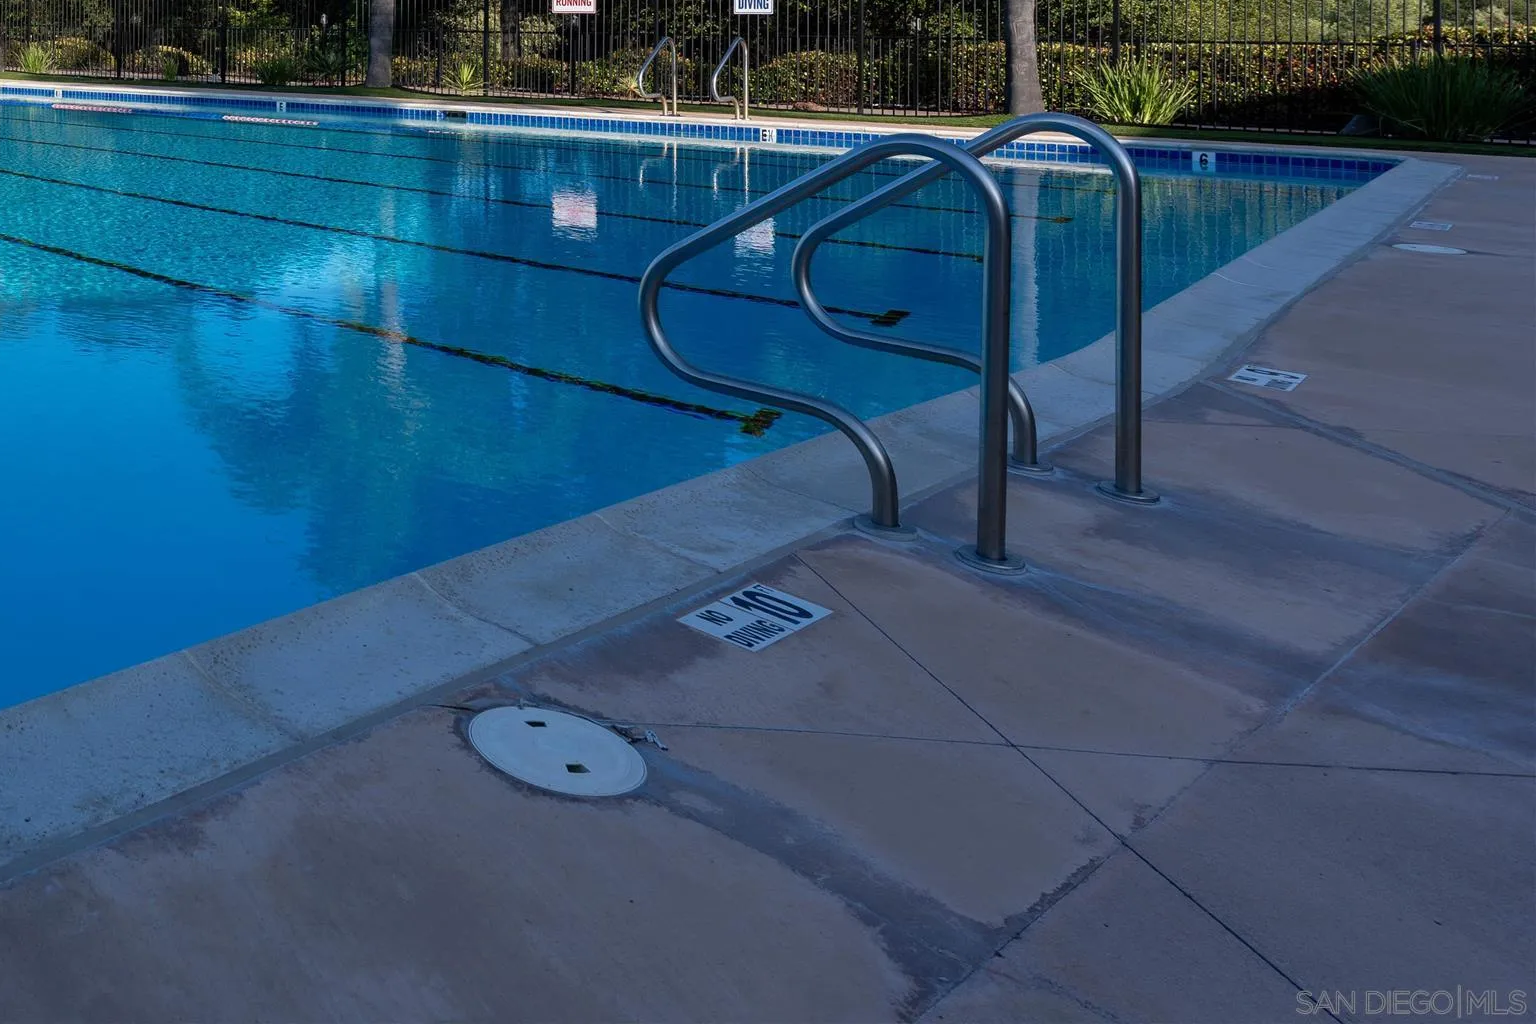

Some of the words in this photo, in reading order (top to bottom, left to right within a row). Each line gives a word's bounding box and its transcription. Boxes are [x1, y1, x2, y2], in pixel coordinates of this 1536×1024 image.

[696, 609, 734, 627] NO
[729, 590, 814, 625] 10
[723, 619, 786, 648] DIVING
